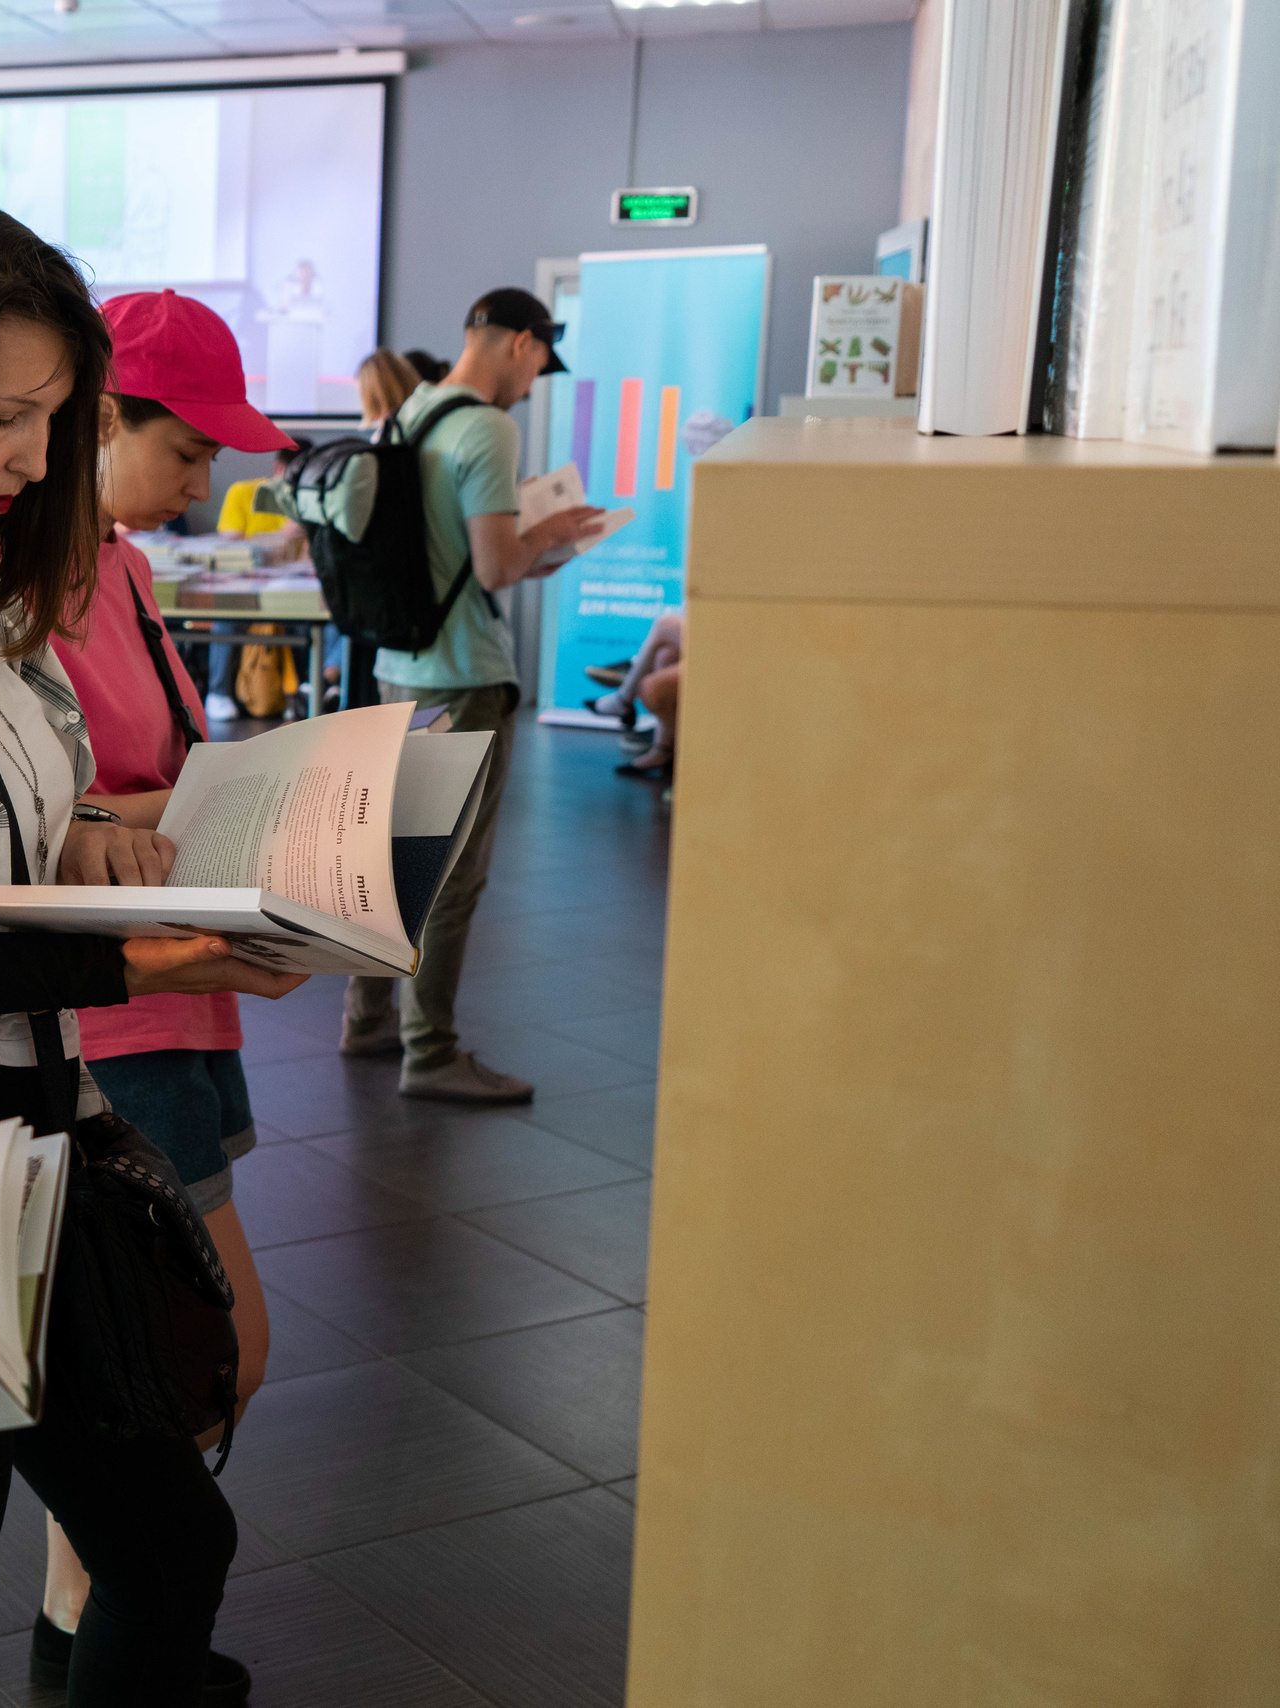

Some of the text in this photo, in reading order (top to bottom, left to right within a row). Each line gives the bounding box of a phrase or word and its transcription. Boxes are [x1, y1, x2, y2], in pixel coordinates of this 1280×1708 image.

[272, 782, 291, 834] unumwunden
[336, 770, 354, 845] unumwunden
[357, 788, 370, 825] mimi
[335, 855, 352, 921] unumwunde
[357, 875, 374, 912] mimi
